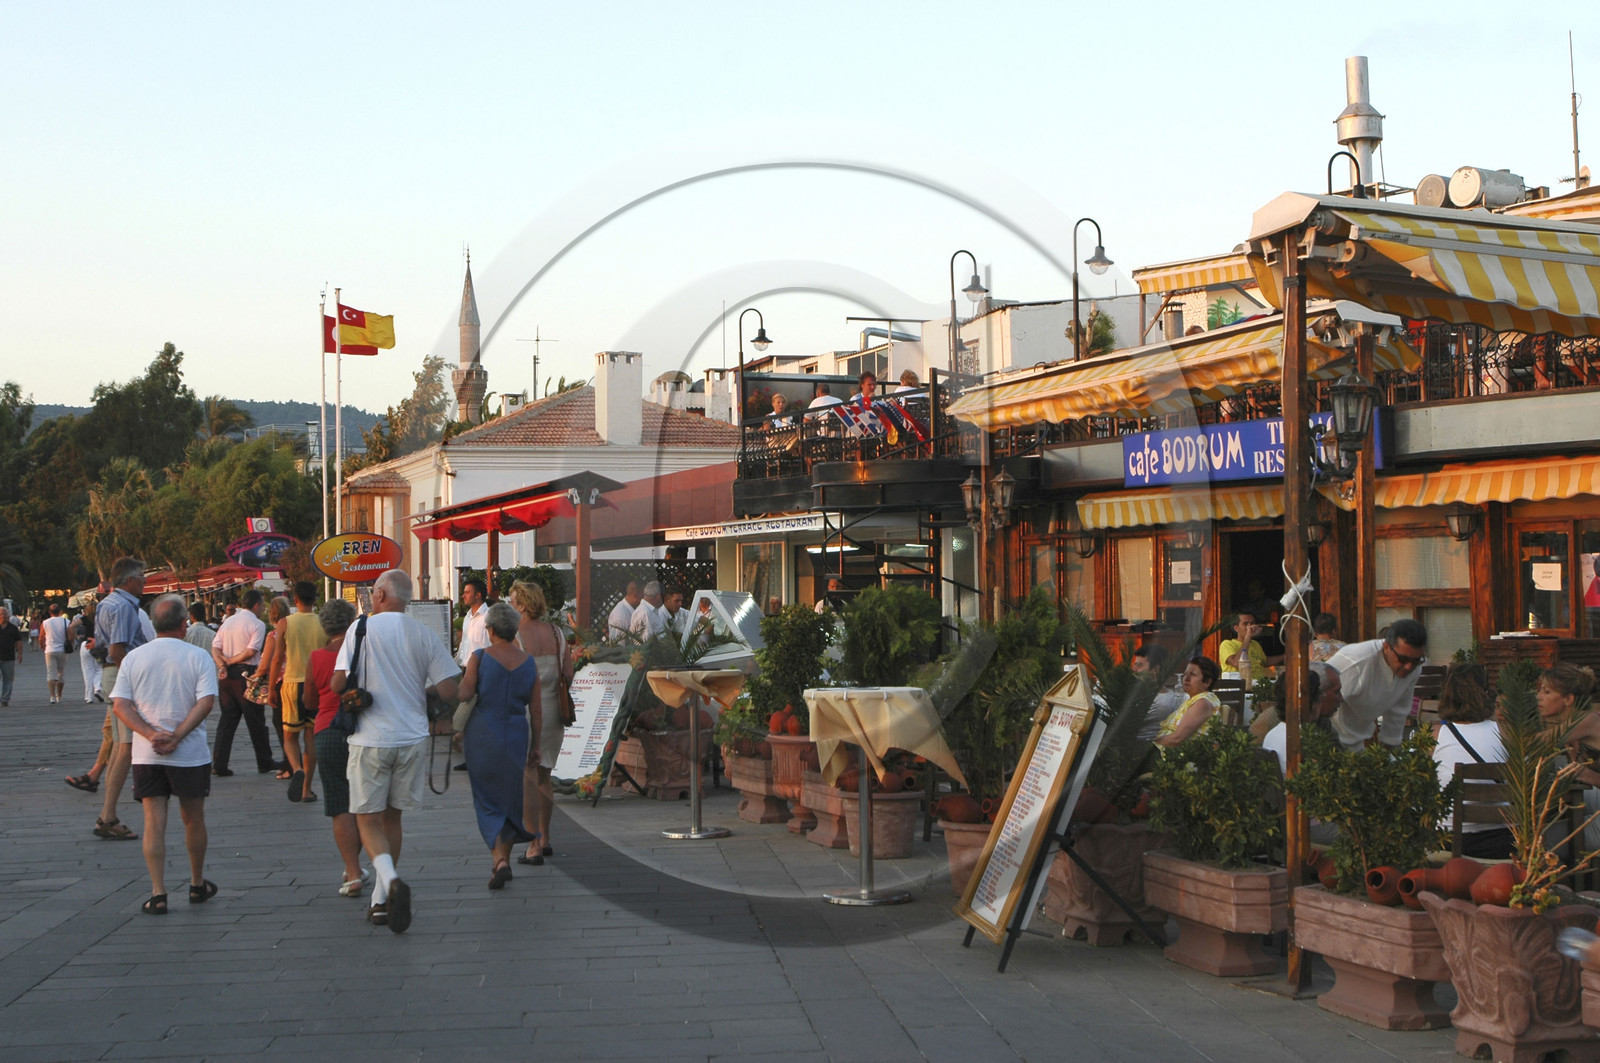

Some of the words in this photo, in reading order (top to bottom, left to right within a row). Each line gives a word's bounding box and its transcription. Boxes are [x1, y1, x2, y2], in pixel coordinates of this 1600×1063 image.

[1128, 434, 1159, 483] cafe
[1162, 430, 1245, 475] BODRUM
[700, 525, 728, 536] BODRUM
[730, 521, 763, 533] TERRACE
[766, 517, 818, 530] RESTAURANT
[343, 539, 382, 555] EREN
[340, 561, 390, 574] Restaurant
